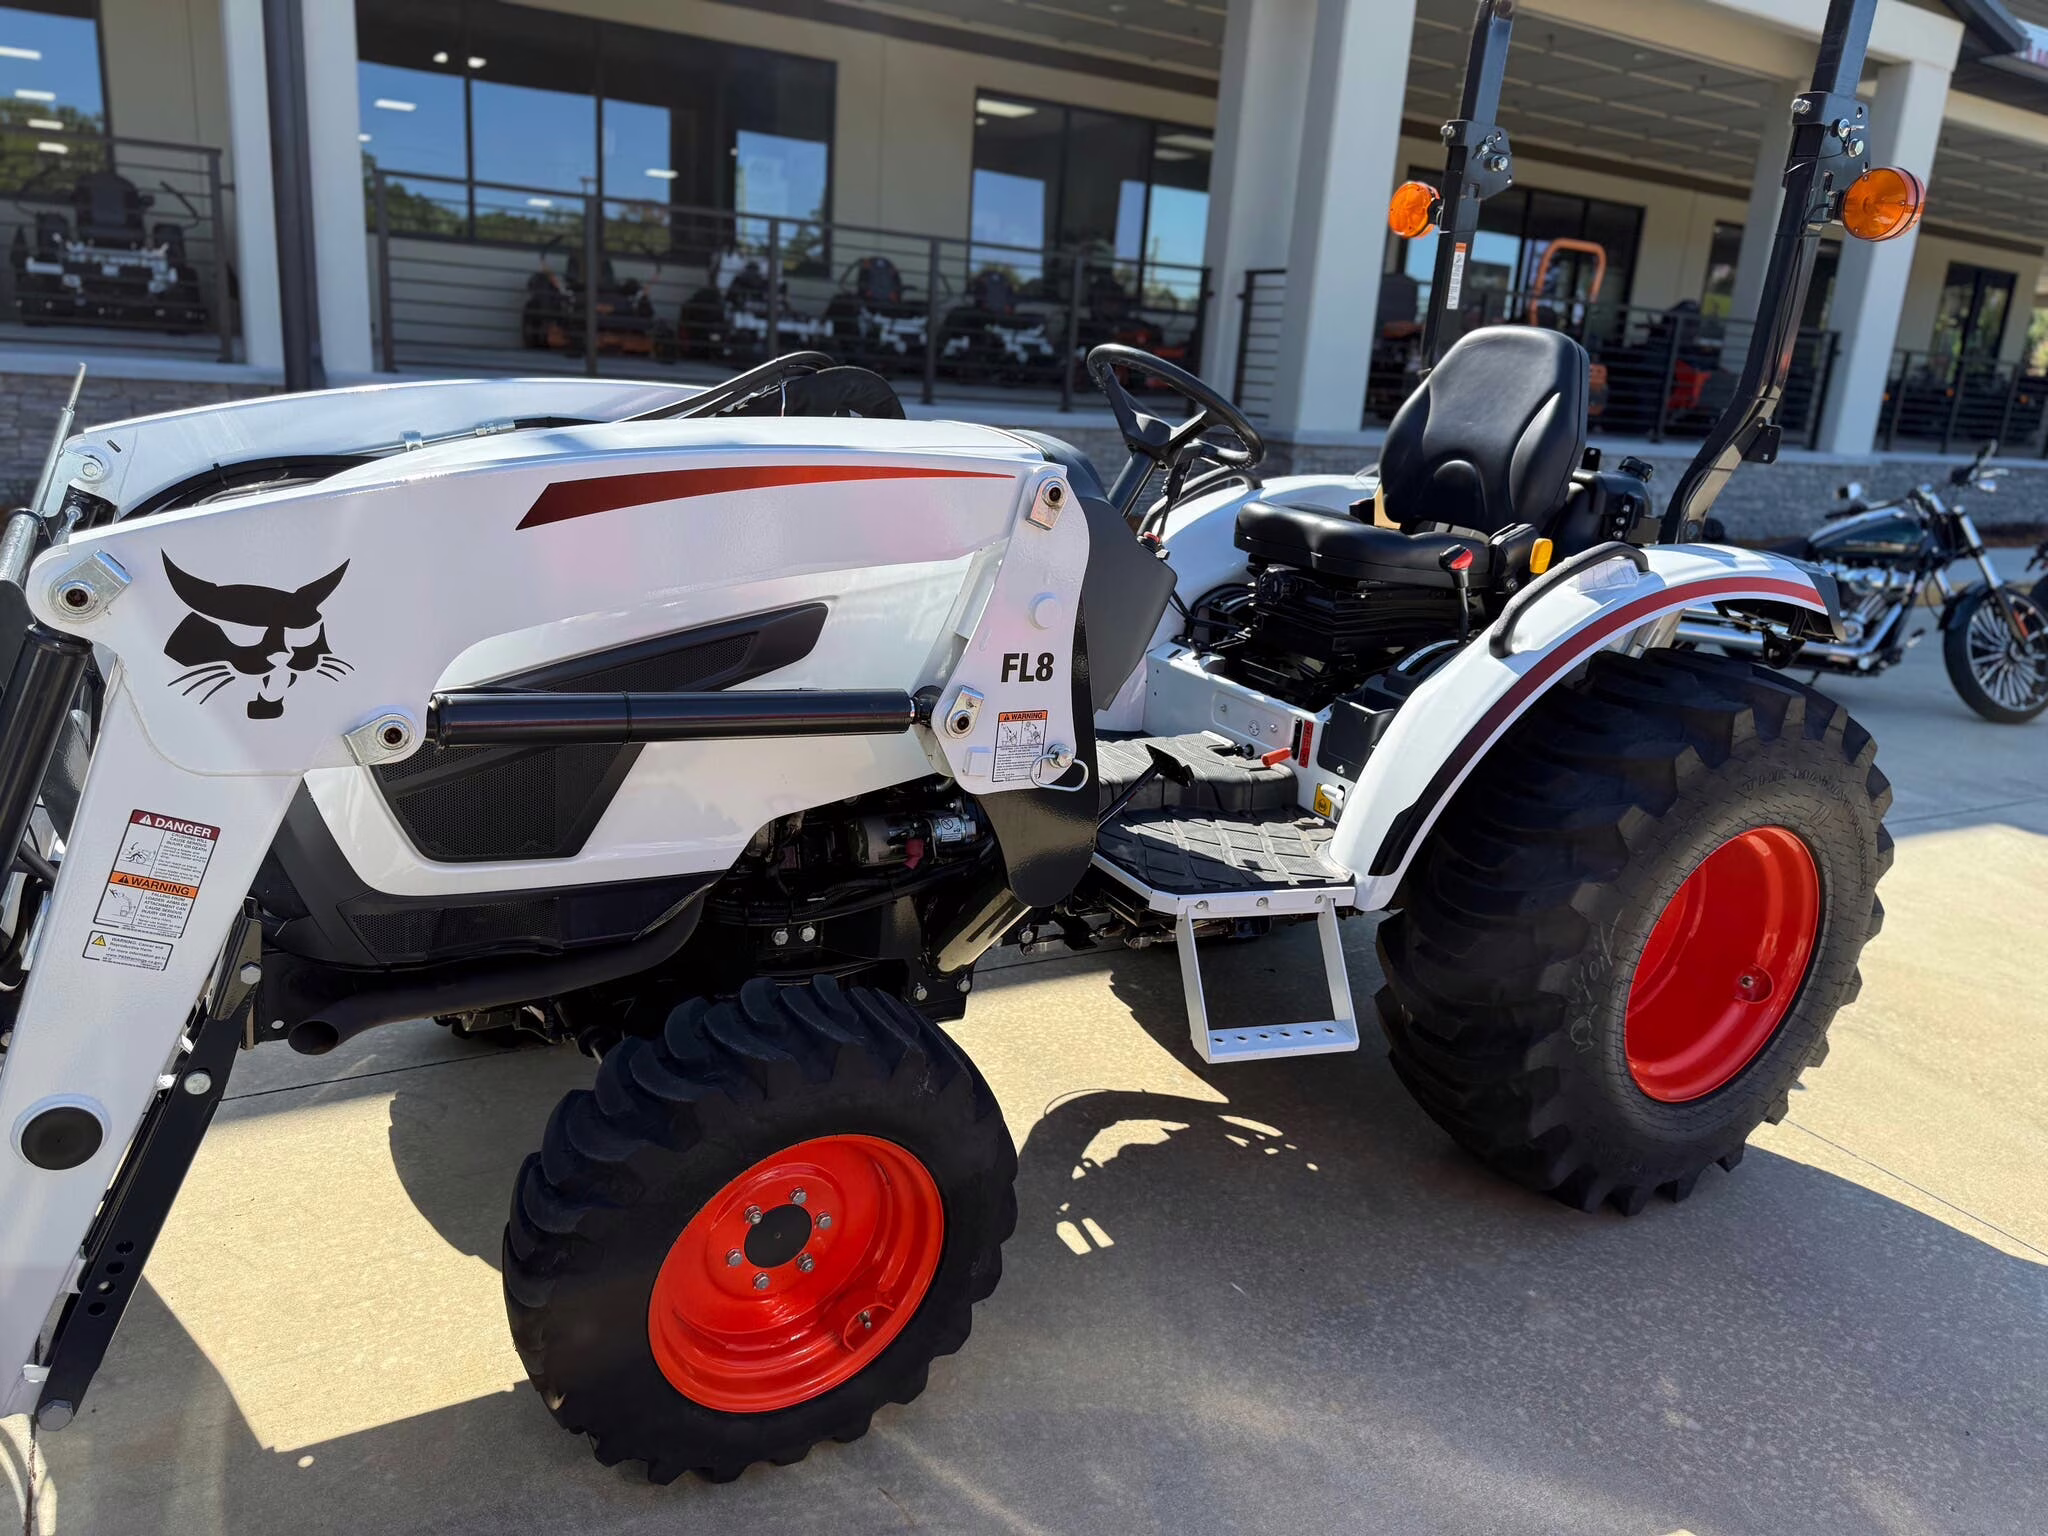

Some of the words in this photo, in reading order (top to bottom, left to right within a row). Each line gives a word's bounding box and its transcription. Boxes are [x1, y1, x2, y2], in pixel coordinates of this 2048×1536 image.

[1000, 652, 1055, 683] FL8
[1011, 712, 1043, 721] WARNING
[154, 817, 212, 838] DANGER
[130, 876, 191, 896] WARNING
